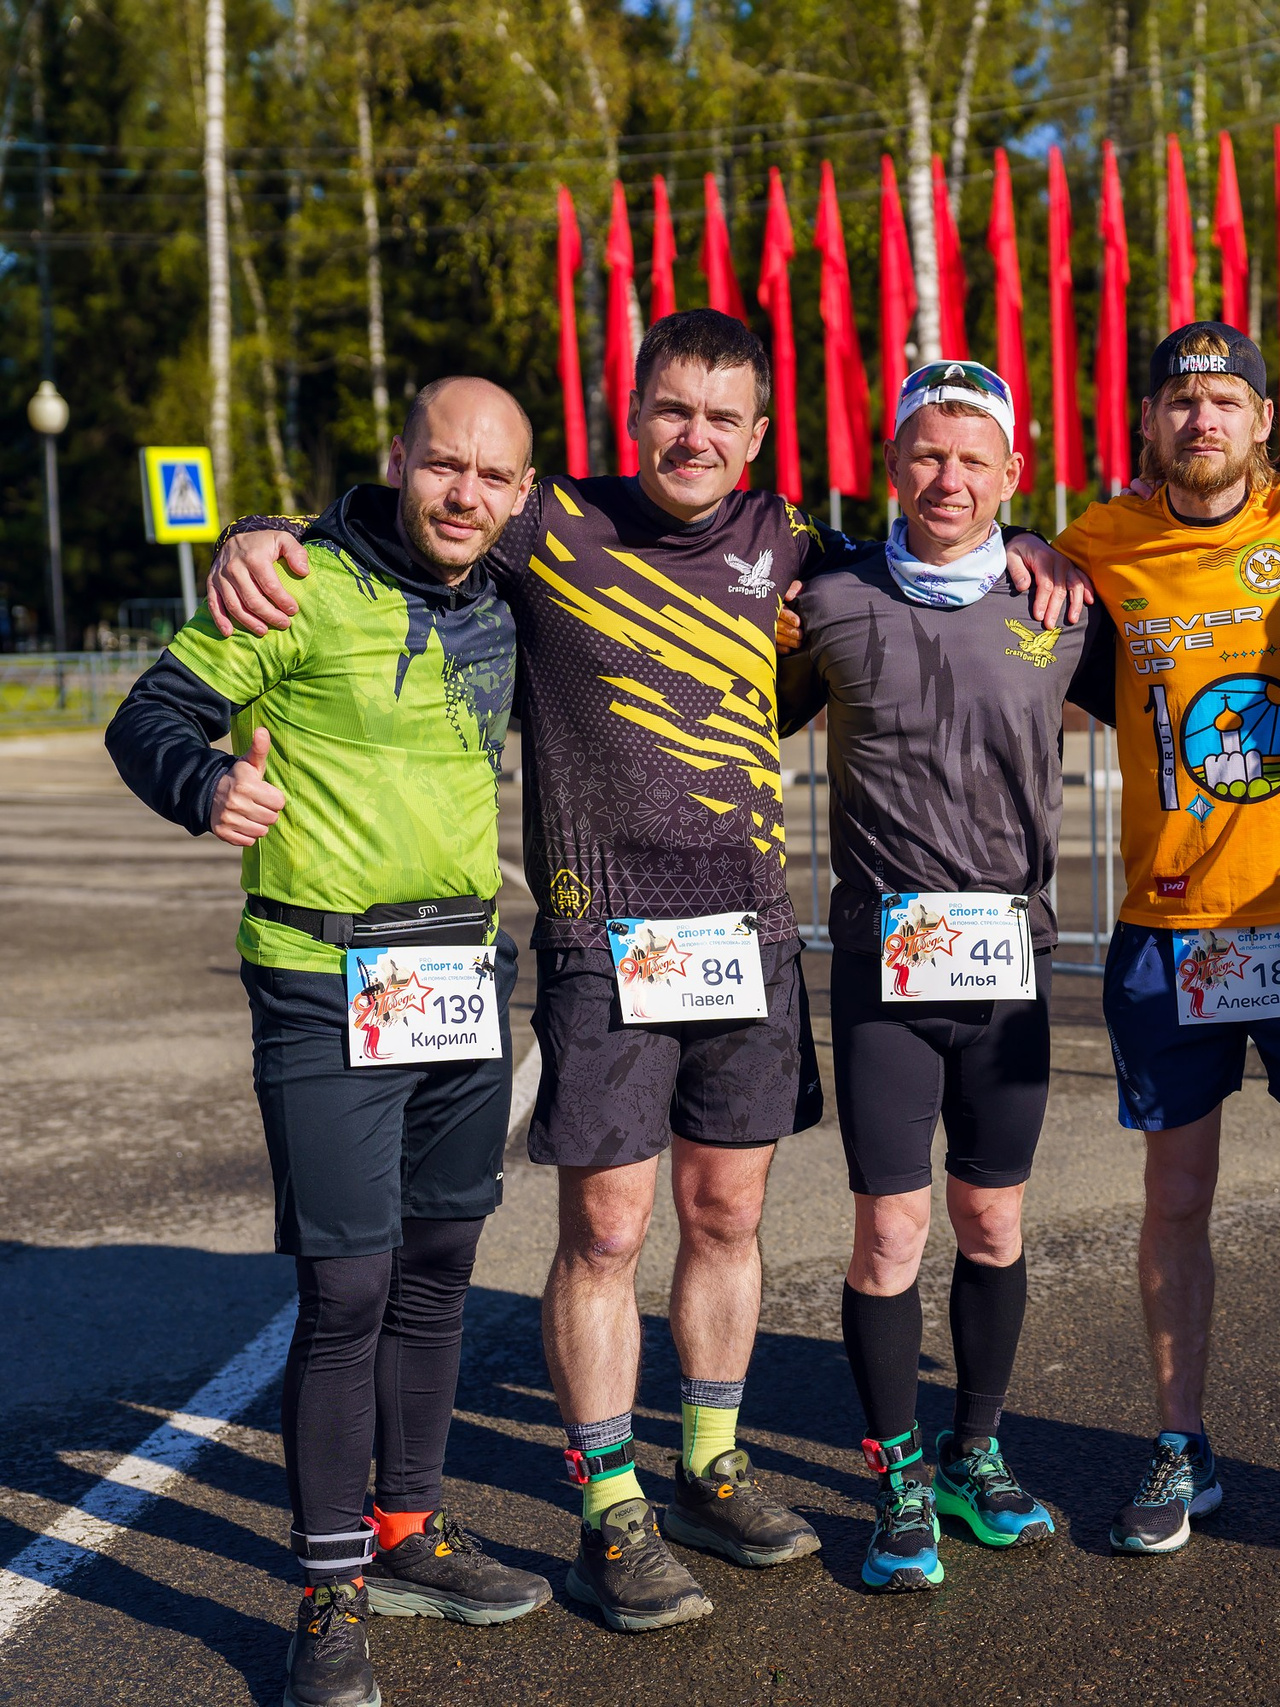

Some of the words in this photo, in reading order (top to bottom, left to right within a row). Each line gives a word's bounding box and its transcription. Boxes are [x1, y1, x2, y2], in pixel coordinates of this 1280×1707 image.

[756, 586, 768, 599] 50
[1123, 606, 1264, 637] NEVER
[1129, 632, 1214, 656] GIVE
[1034, 656, 1048, 668] 50
[1133, 657, 1176, 675] UP
[1159, 721, 1174, 776] GRUT
[950, 908, 985, 916] СПОРТ
[678, 929, 713, 939] СПОРТ
[713, 928, 726, 936] 40
[1238, 933, 1272, 942] СПОРТ
[970, 939, 1014, 966] 44
[420, 963, 451, 971] СПОРТ
[452, 962, 464, 971] 40
[702, 958, 744, 986] 84
[950, 972, 996, 986] Илья
[682, 993, 734, 1007] Павел
[433, 994, 485, 1025] 139
[411, 1032, 478, 1050] Кирилл
